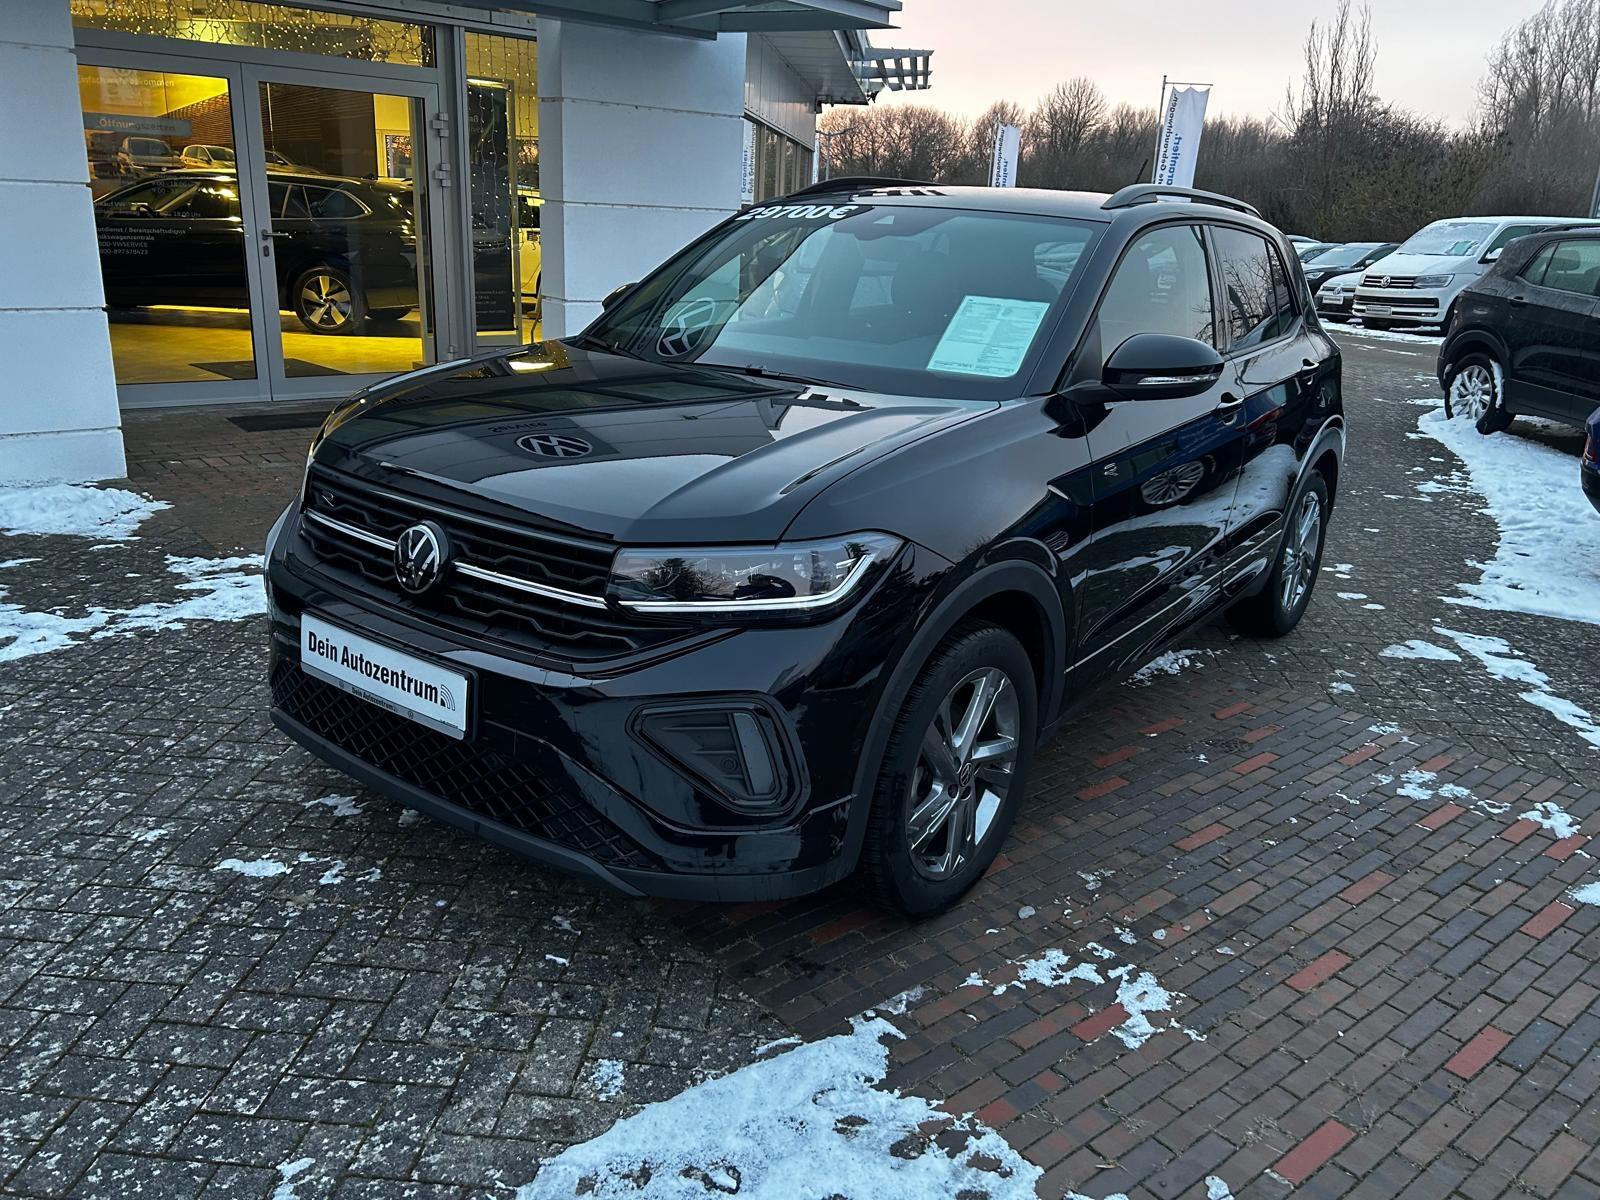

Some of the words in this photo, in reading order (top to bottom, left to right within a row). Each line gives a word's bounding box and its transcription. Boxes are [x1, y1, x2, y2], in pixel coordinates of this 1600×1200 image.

[734, 205, 860, 221] 29700€
[308, 630, 338, 663] Dein
[340, 644, 439, 704] Autozentrum
